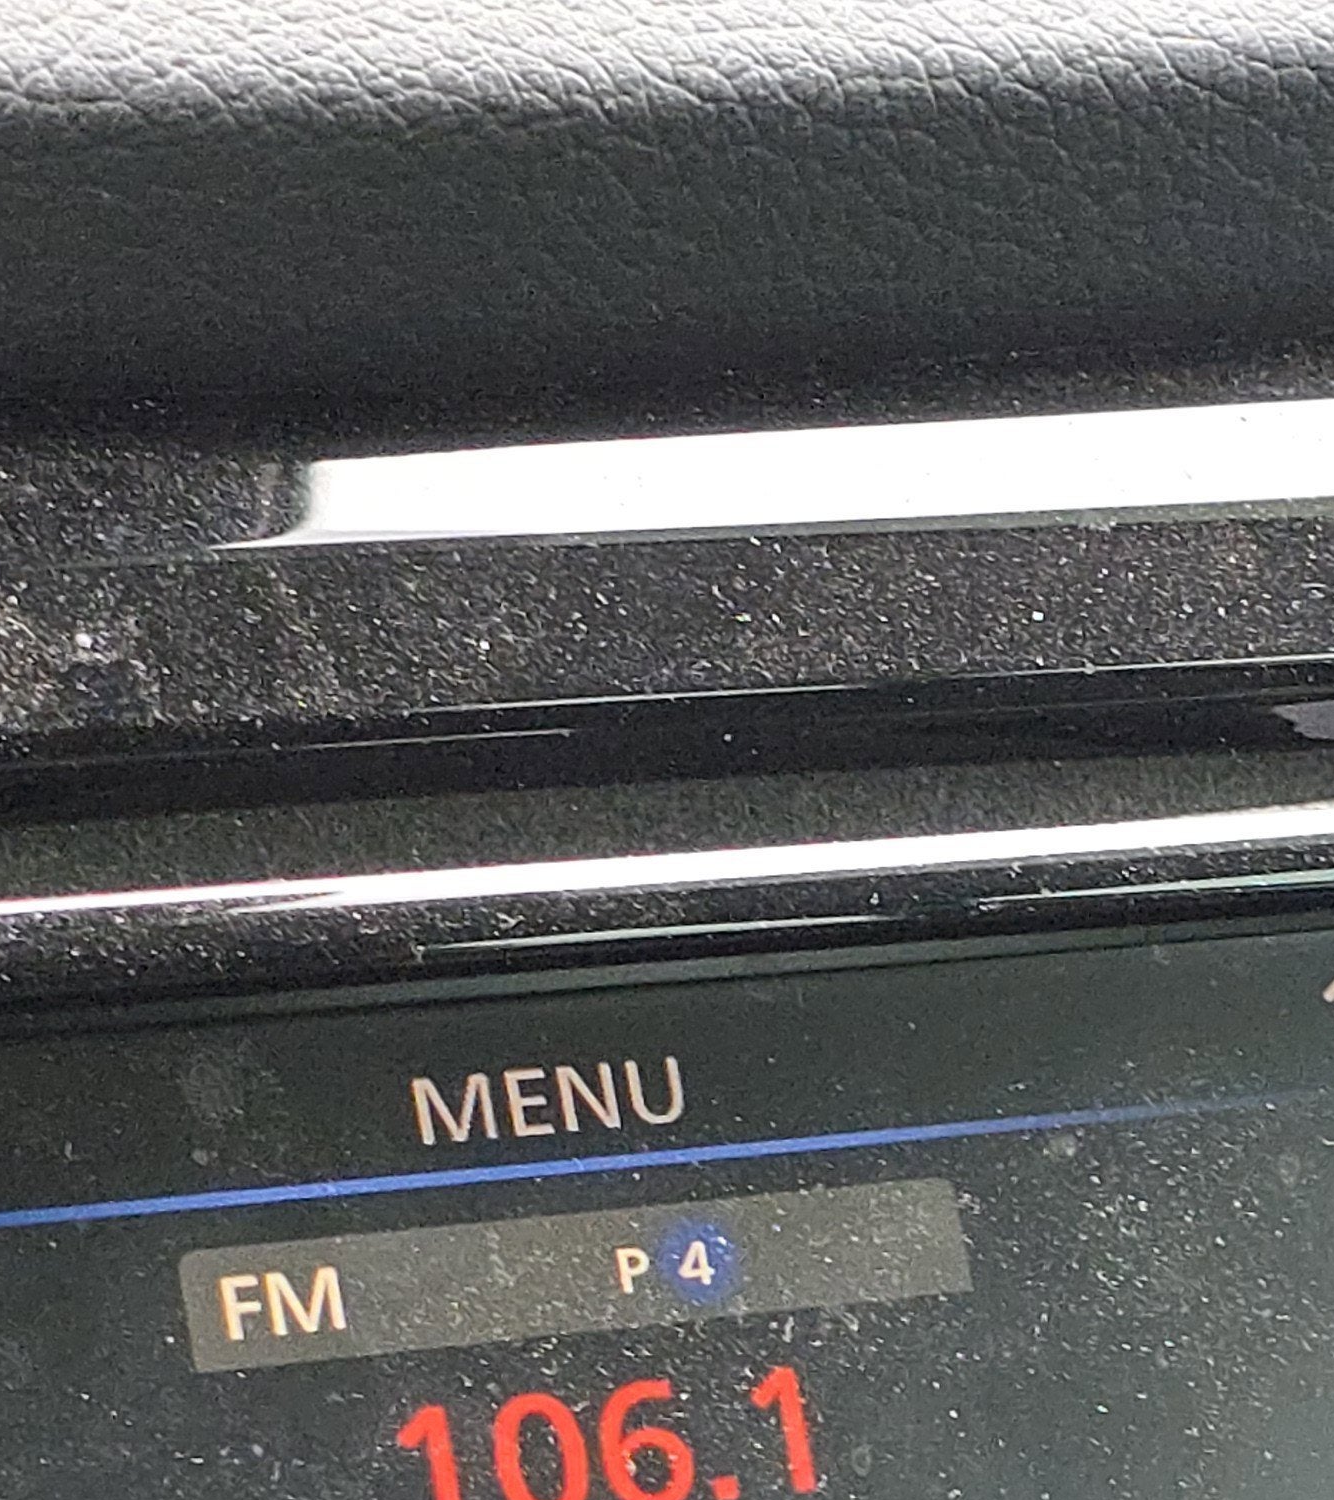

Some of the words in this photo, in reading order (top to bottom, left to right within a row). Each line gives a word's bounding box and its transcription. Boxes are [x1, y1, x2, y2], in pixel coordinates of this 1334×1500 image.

[411, 1056, 687, 1146] MENU
[218, 1265, 348, 1342] FM
[614, 1246, 651, 1294] P
[677, 1240, 716, 1286] 4
